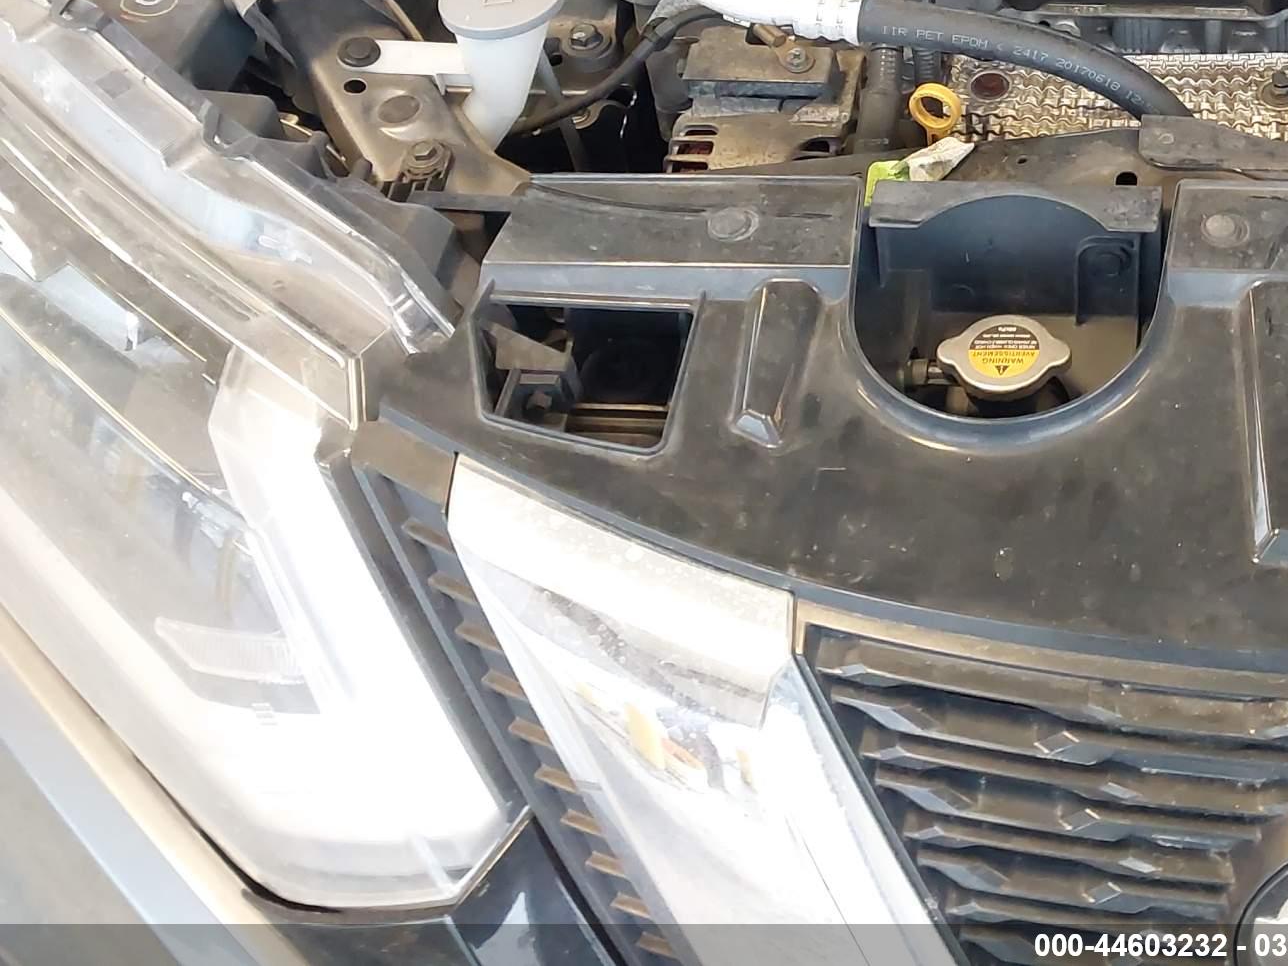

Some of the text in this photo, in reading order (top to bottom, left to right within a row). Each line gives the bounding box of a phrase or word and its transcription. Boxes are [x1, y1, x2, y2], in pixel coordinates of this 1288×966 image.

[916, 29, 944, 41] PET
[1013, 45, 1049, 62] 2417
[1056, 57, 1121, 91] 20170618
